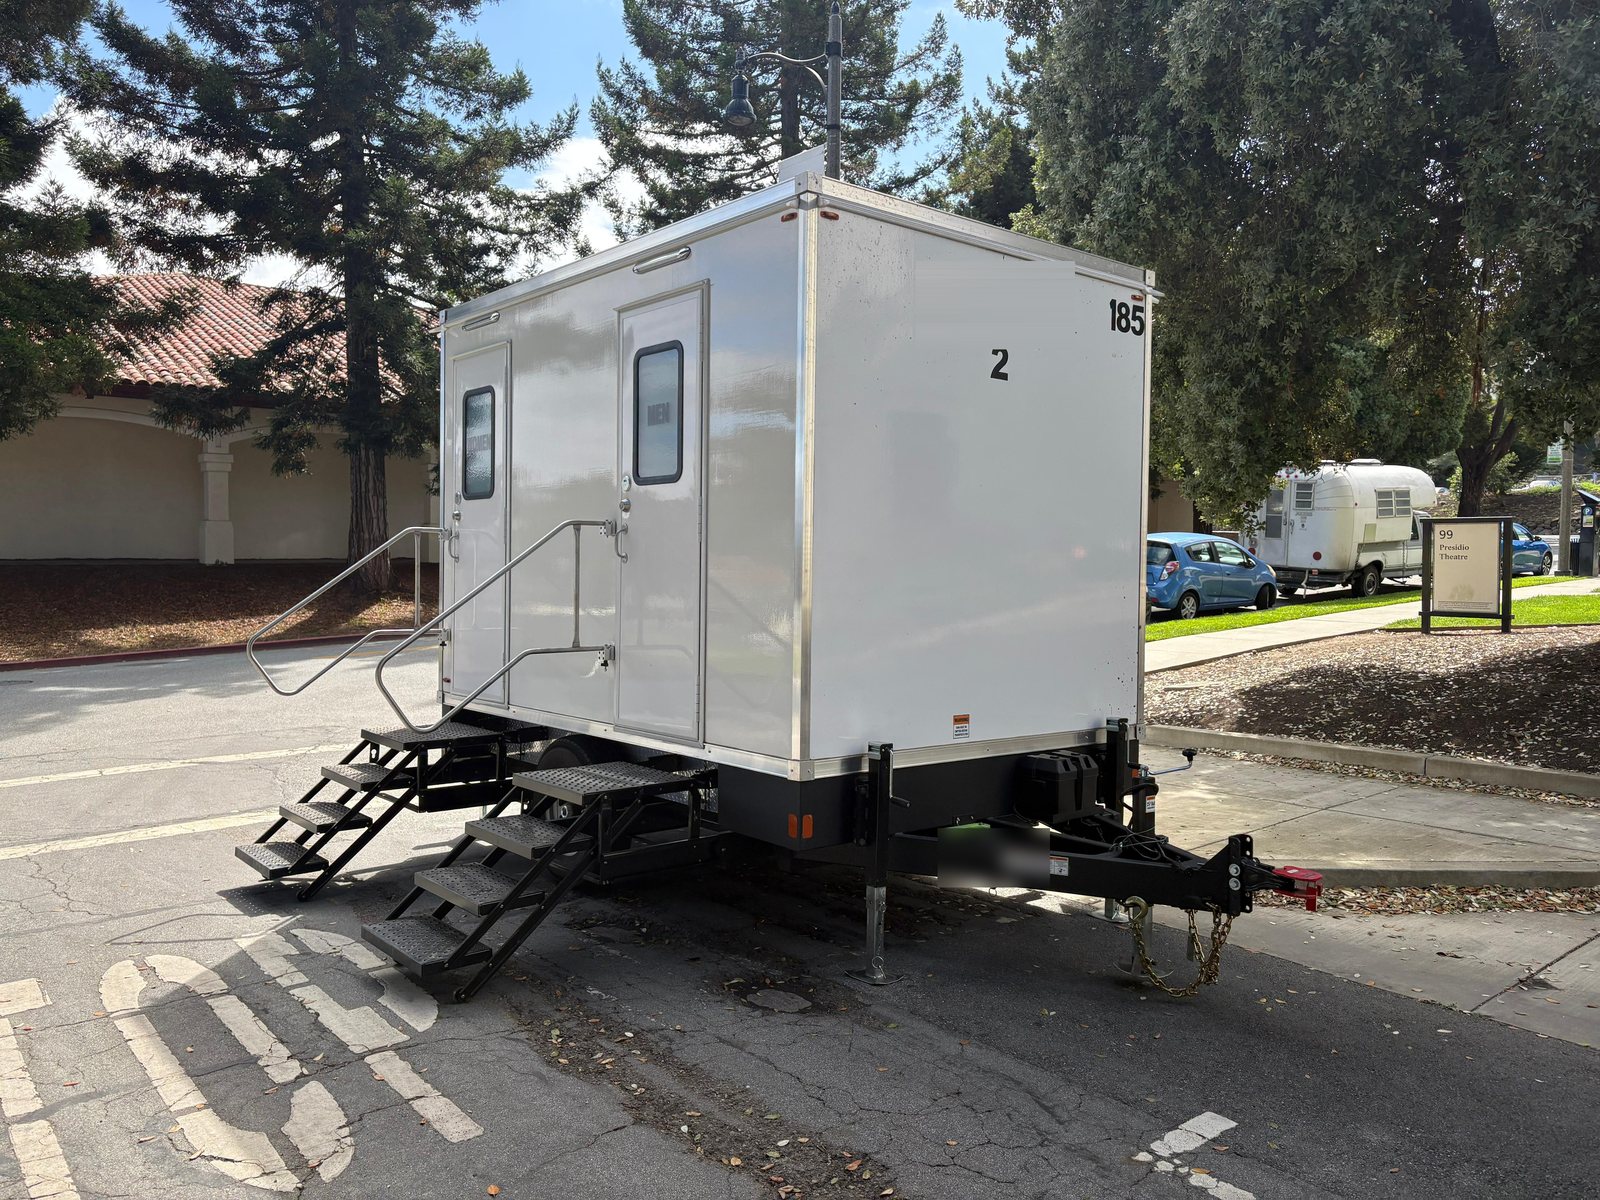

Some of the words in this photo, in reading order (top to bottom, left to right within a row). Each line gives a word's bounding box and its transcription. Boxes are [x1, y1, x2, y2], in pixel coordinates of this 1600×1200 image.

[1110, 299, 1144, 336] 185
[990, 349, 1009, 381] 2
[1438, 529, 1454, 540] 99
[1439, 543, 1470, 551] Presidio
